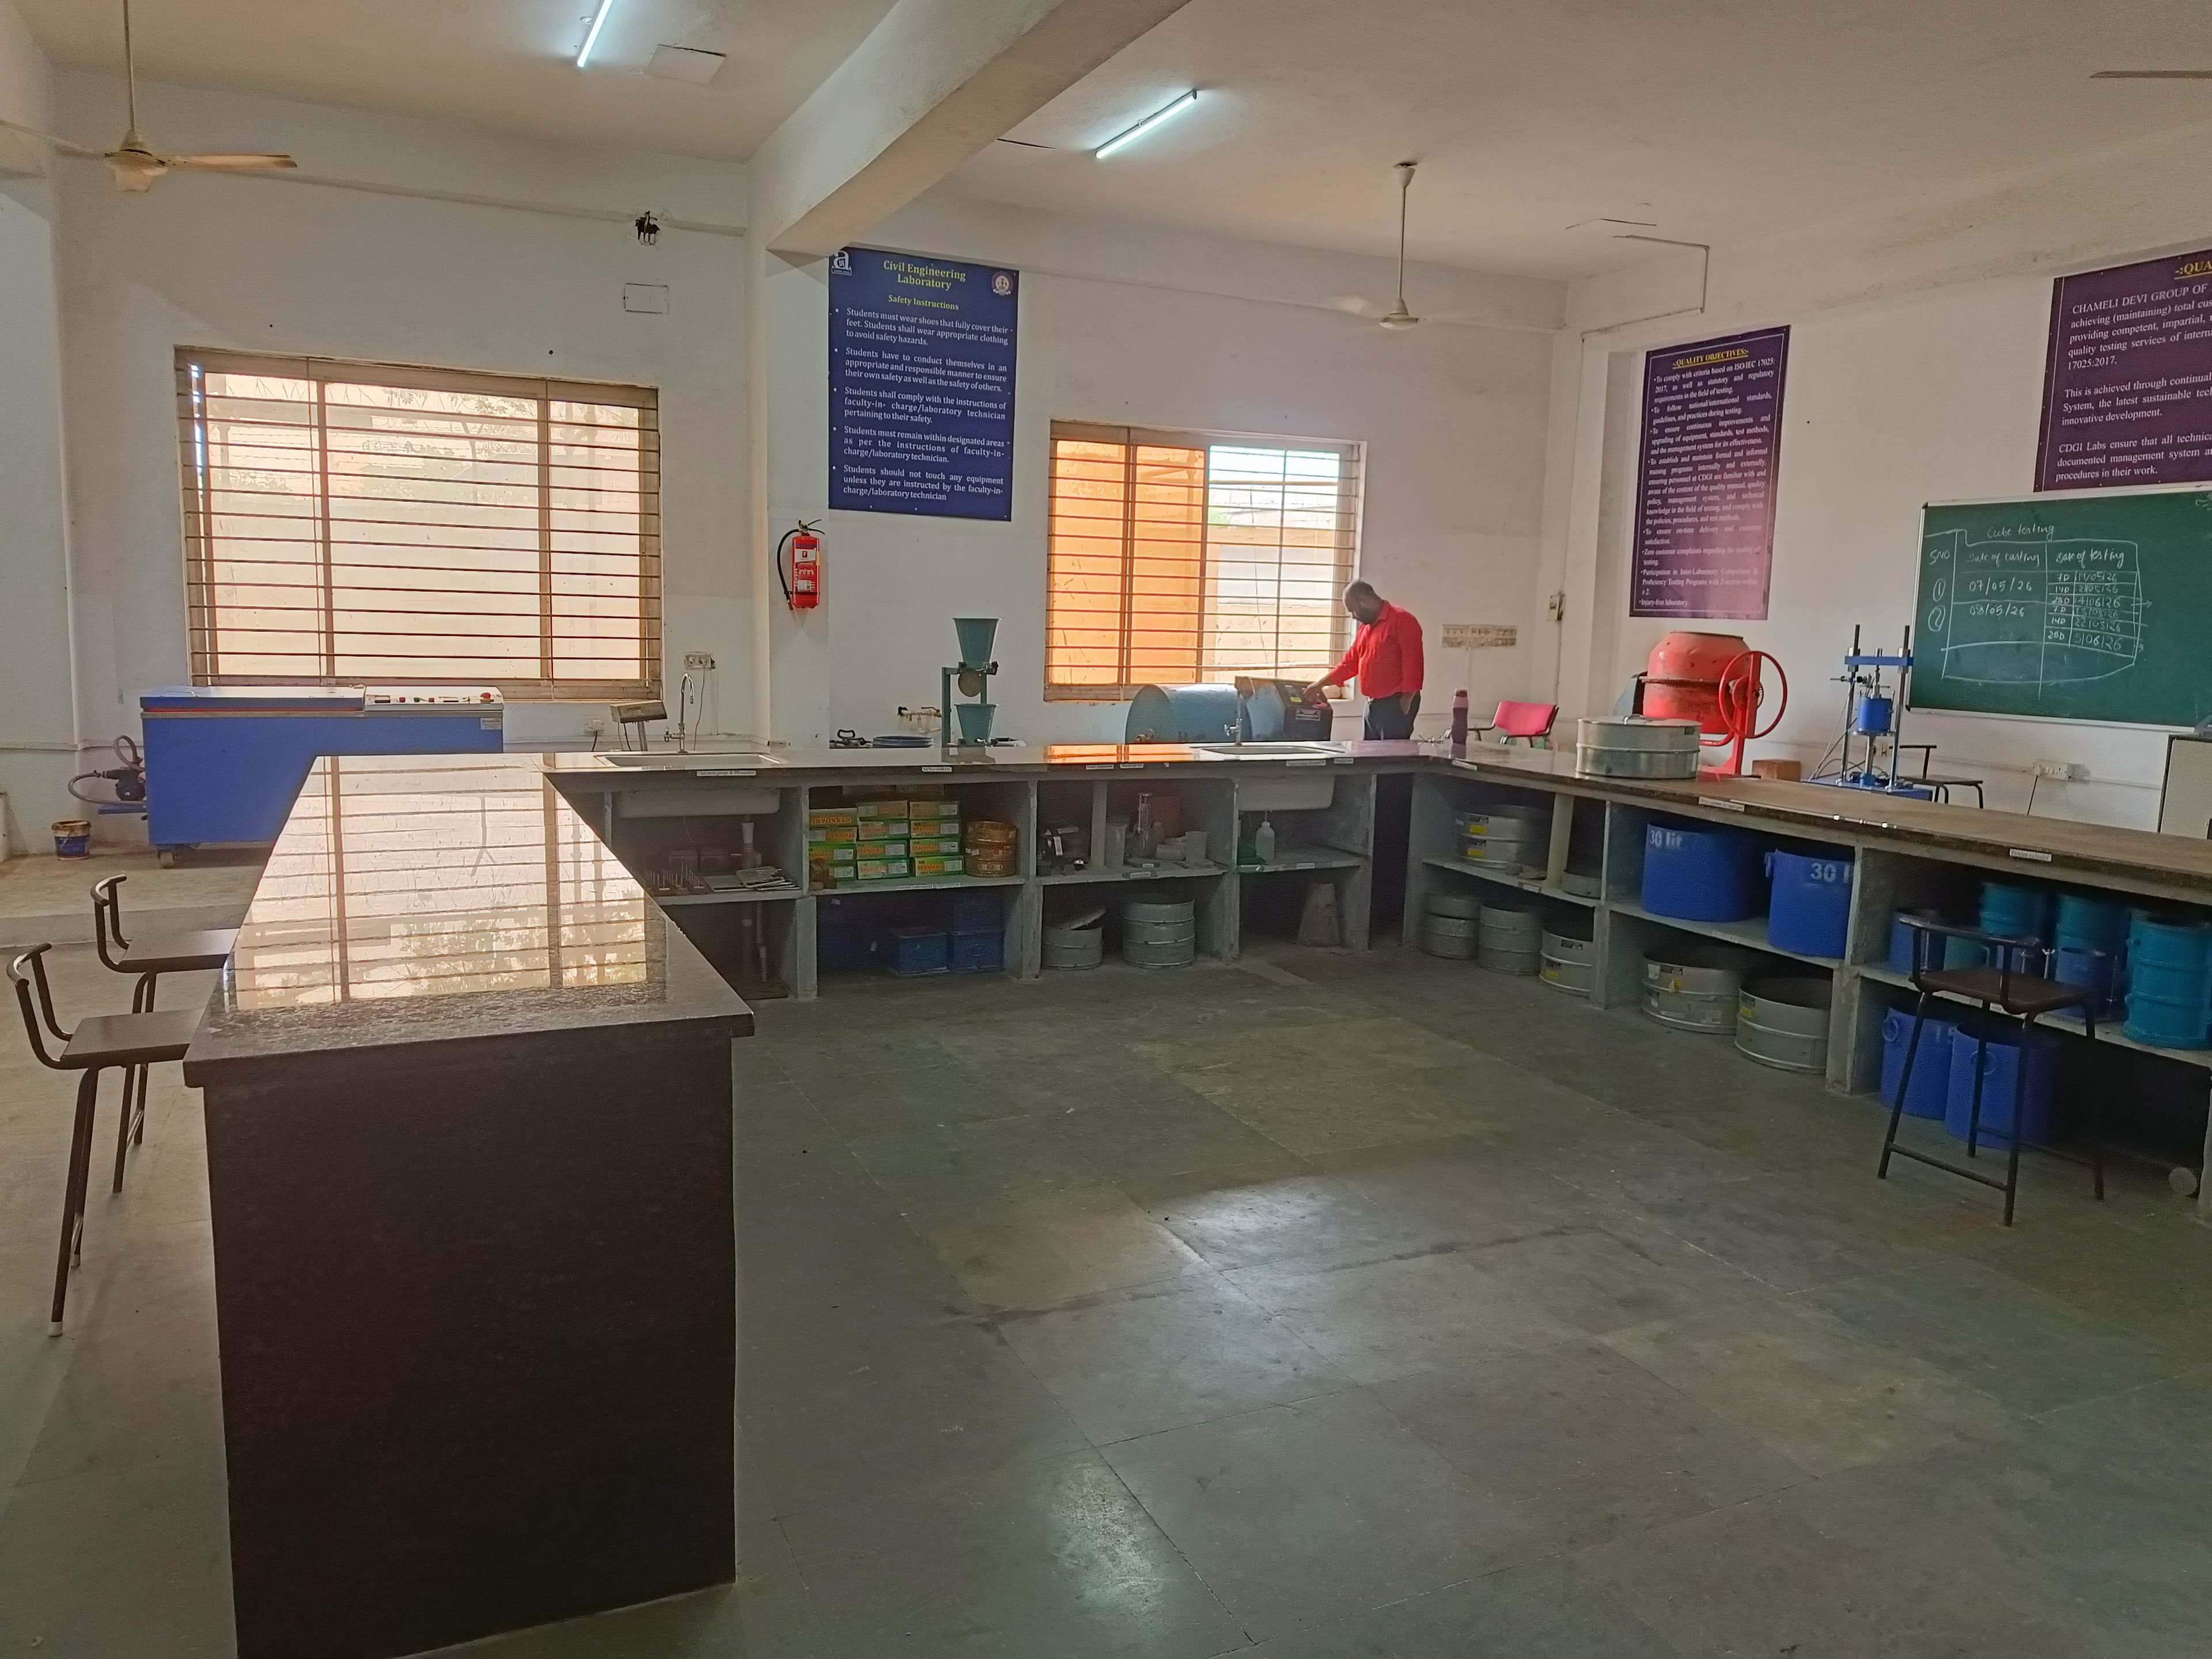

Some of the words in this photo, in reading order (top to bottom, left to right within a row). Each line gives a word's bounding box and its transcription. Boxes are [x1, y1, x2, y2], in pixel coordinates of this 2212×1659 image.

[884, 260, 904, 271] Civil
[907, 263, 965, 281] Engineering
[897, 274, 951, 290] Laboratory
[888, 294, 911, 305] Safety
[914, 298, 959, 310] Instructions
[2072, 298, 2118, 314] CHAMELI
[2122, 294, 2147, 306] DEVI
[2151, 286, 2188, 301] GROUP
[2192, 283, 2207, 294] OF
[846, 308, 878, 318] Students
[918, 316, 938, 325] shoes
[940, 319, 954, 327] that
[955, 320, 971, 330] fully
[991, 325, 1008, 334] their
[2071, 315, 2110, 328] achieving
[2112, 305, 2171, 323] (maintaining)
[2174, 300, 2194, 312] total
[846, 318, 862, 327] feet.
[864, 320, 896, 331] Students
[898, 324, 915, 333] shall
[936, 331, 978, 340] appropriate
[980, 334, 1007, 346] clothing
[2069, 329, 2109, 344] providing
[2112, 323, 2158, 336] competent,
[2162, 313, 2205, 328] impartial,
[876, 333, 897, 343] safety
[898, 334, 927, 345] hazards.
[2068, 344, 2096, 357] quality
[2100, 341, 2127, 351] testing
[2131, 336, 2165, 347] services
[2170, 331, 2181, 342] of
[845, 359, 889, 369] appropriate
[905, 366, 946, 375] responsible
[846, 347, 878, 357] Students
[882, 350, 899, 359] have
[914, 355, 942, 364] conduct
[946, 358, 984, 369] themselves
[988, 362, 994, 370] in
[2068, 355, 2117, 370] 17025:2017.
[845, 368, 863, 377] their
[881, 373, 903, 382] safety
[937, 378, 948, 386] the
[949, 380, 969, 389] safety
[978, 382, 1002, 391] others.
[2064, 388, 2082, 397] This
[2085, 387, 2091, 395] is
[2093, 381, 2130, 395] achieved
[2133, 377, 2166, 389] through
[2169, 372, 2211, 385] continual
[844, 387, 877, 396] Students
[879, 389, 896, 399] shall
[897, 393, 924, 403] comply
[925, 395, 941, 403] with
[943, 396, 955, 404] the
[956, 397, 997, 408] instructions
[2063, 403, 2094, 413] System,
[2099, 399, 2111, 407] the
[2116, 396, 2138, 406] latest
[2142, 389, 2191, 403] sustainable
[844, 397, 885, 408] faculty-in-
[891, 402, 961, 417] charge/laboratory
[967, 410, 1005, 419] technician
[844, 409, 882, 420] pertaining
[892, 412, 910, 421] their
[910, 414, 932, 424] safety.
[2062, 414, 2103, 425] innovative
[2105, 408, 2162, 421] development.
[844, 426, 876, 435] Students
[923, 433, 946, 442] within
[947, 434, 984, 445] designated
[2059, 442, 2082, 453] CDGI
[2086, 441, 2106, 450] Labs
[2109, 440, 2137, 449] ensure
[2141, 437, 2157, 446] that
[2161, 434, 2172, 444] all
[843, 446, 910, 460] charge/laboratory
[911, 453, 949, 462] technician.
[878, 439, 891, 447] the
[897, 441, 945, 452] instructions
[964, 446, 1004, 457] faculty-in-
[2057, 454, 2105, 467] documented
[2110, 451, 2164, 463] management
[2168, 449, 2199, 460] system
[844, 464, 876, 474] Students
[880, 467, 904, 476] should
[966, 475, 1003, 484] equipment
[2055, 470, 2099, 482] procedures
[2101, 468, 2109, 477] in
[2112, 467, 2131, 476] their
[2134, 465, 2157, 475] work.
[843, 475, 866, 484] unless
[870, 477, 886, 487] they
[903, 479, 940, 489] instructed
[942, 482, 951, 491] by
[954, 483, 965, 491] the
[968, 484, 1003, 494] faculty-in-
[843, 486, 910, 499] charge/laboratory
[910, 491, 946, 500] technician
[1969, 577, 2032, 595] 07/05/26
[1649, 830, 1662, 847] 30
[1810, 862, 1836, 882] 30
